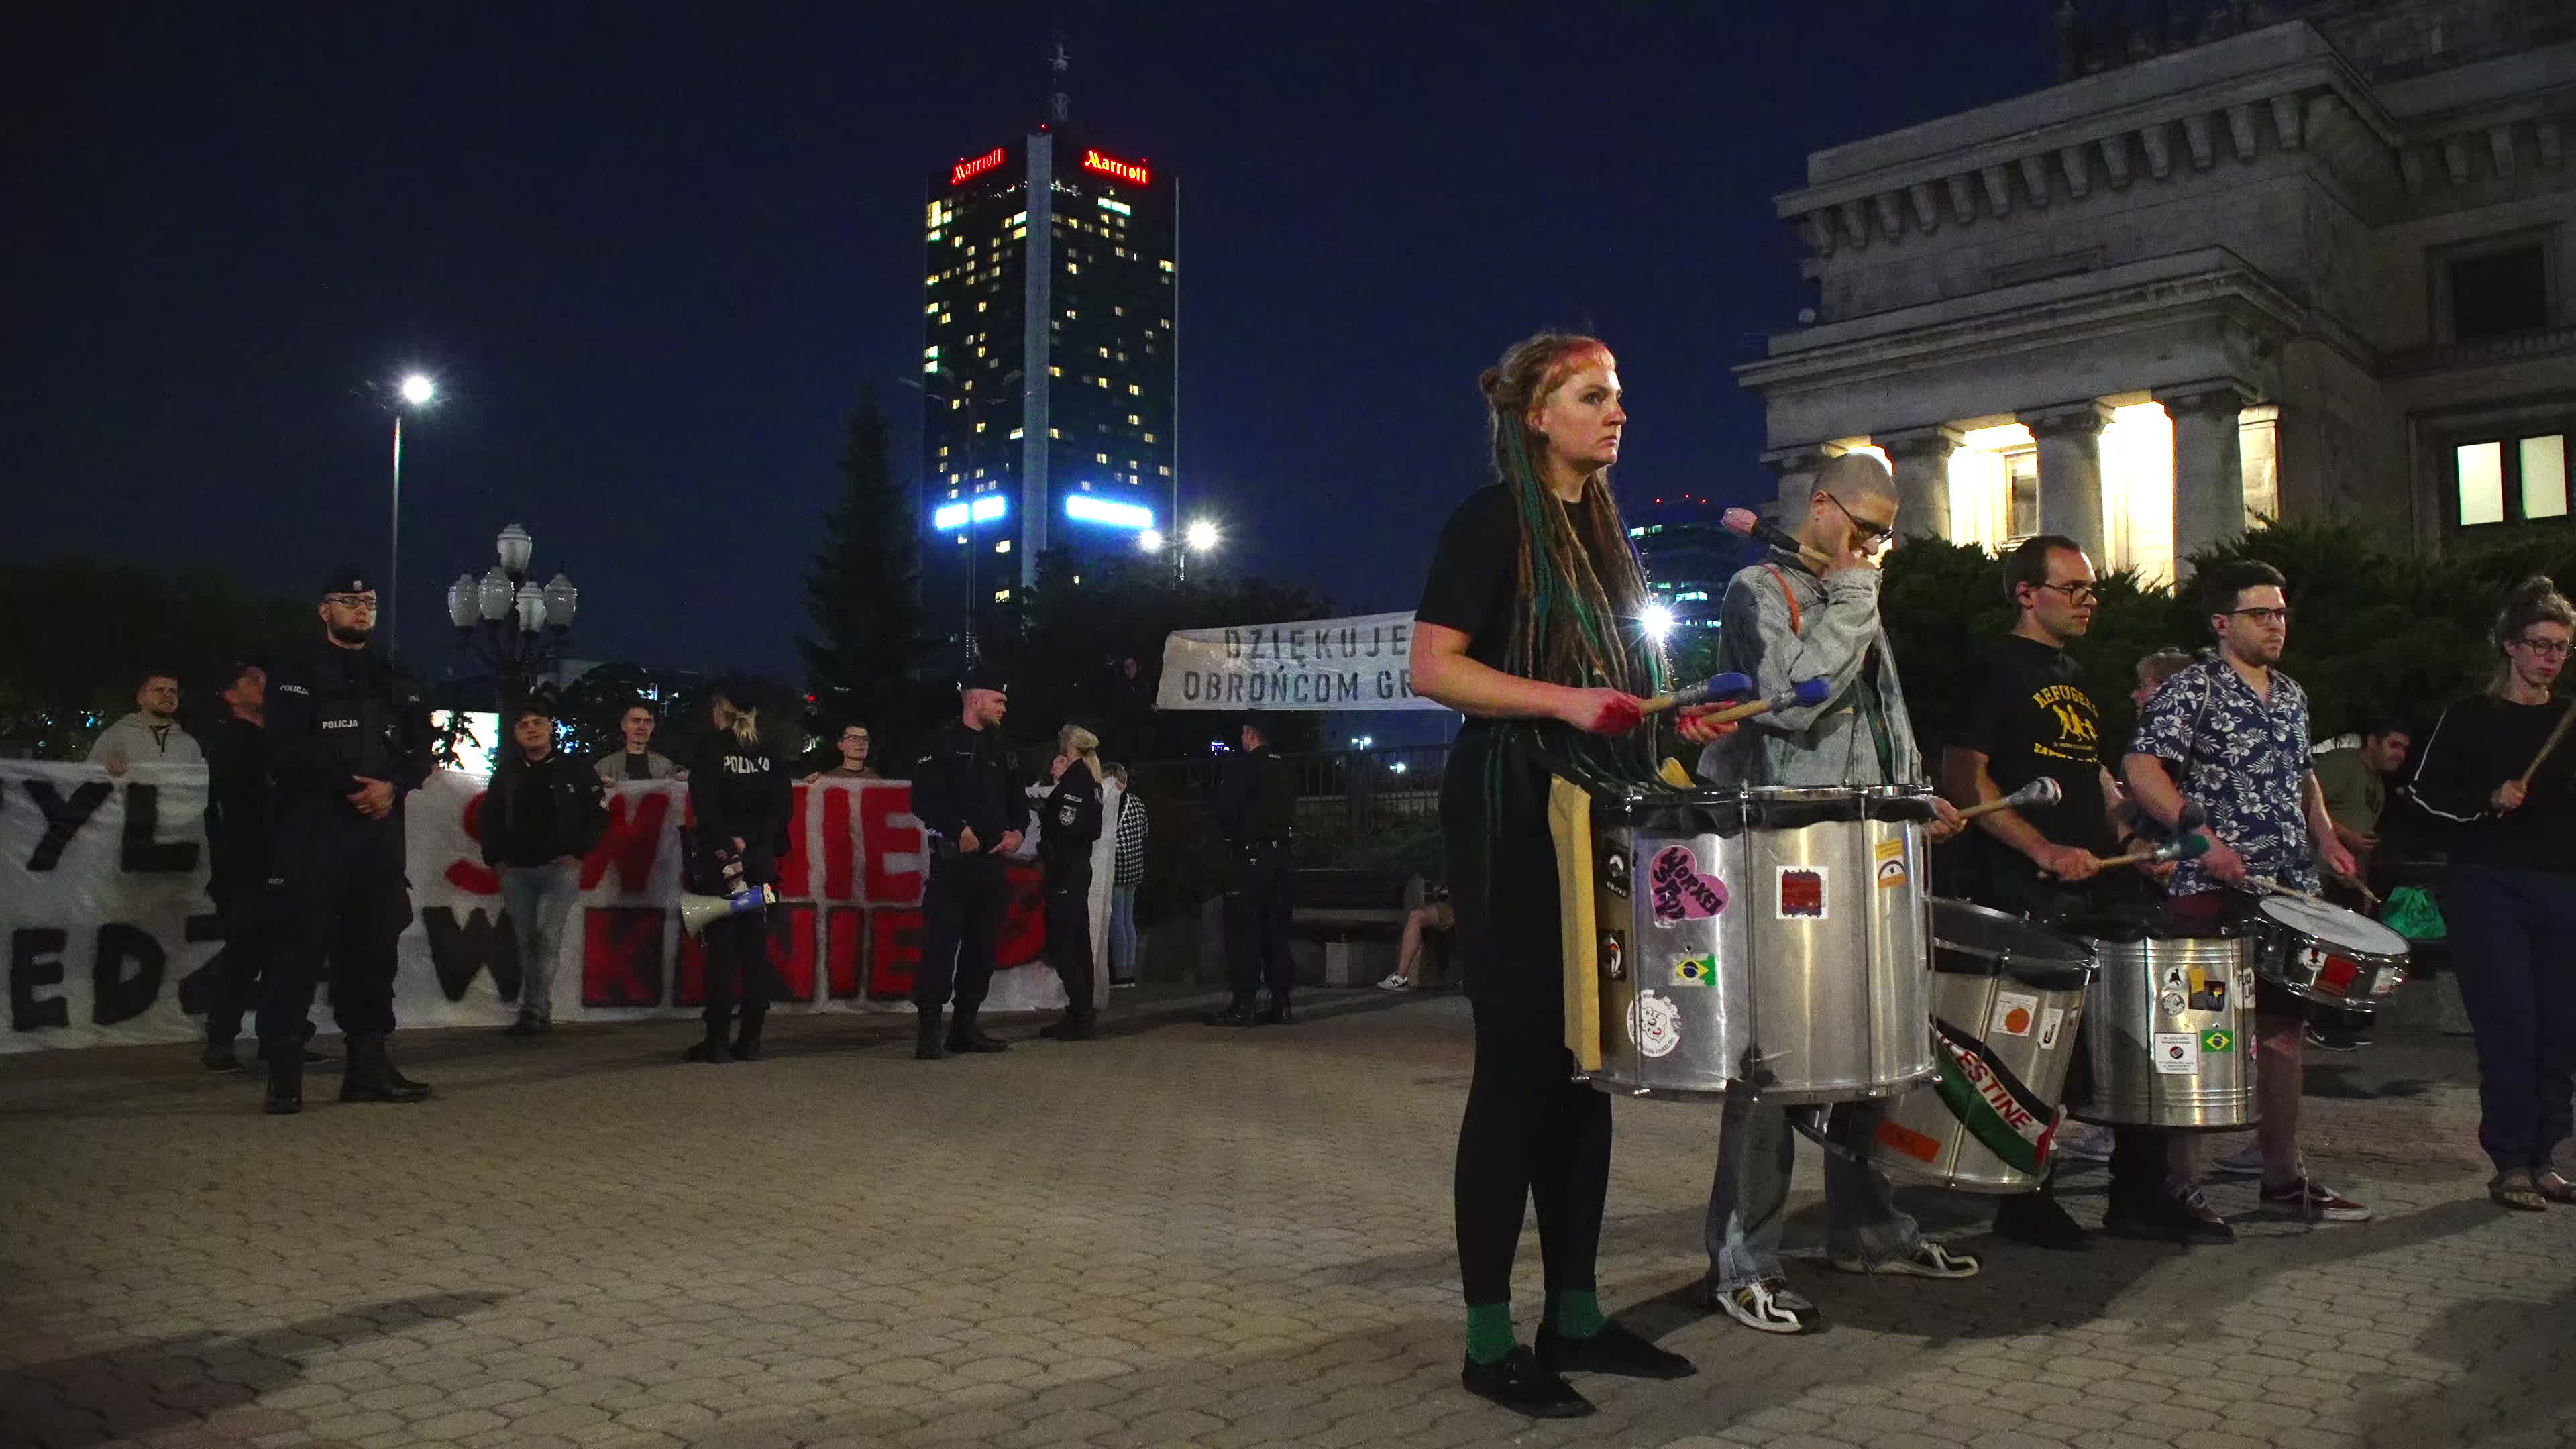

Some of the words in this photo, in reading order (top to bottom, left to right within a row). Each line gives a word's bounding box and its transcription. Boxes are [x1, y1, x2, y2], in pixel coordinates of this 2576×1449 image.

[952, 148, 1002, 184] Marriott
[1084, 150, 1148, 184] Marriott
[1183, 665, 1358, 702] OBROŃCOM
[322, 719, 358, 729] POLICJA
